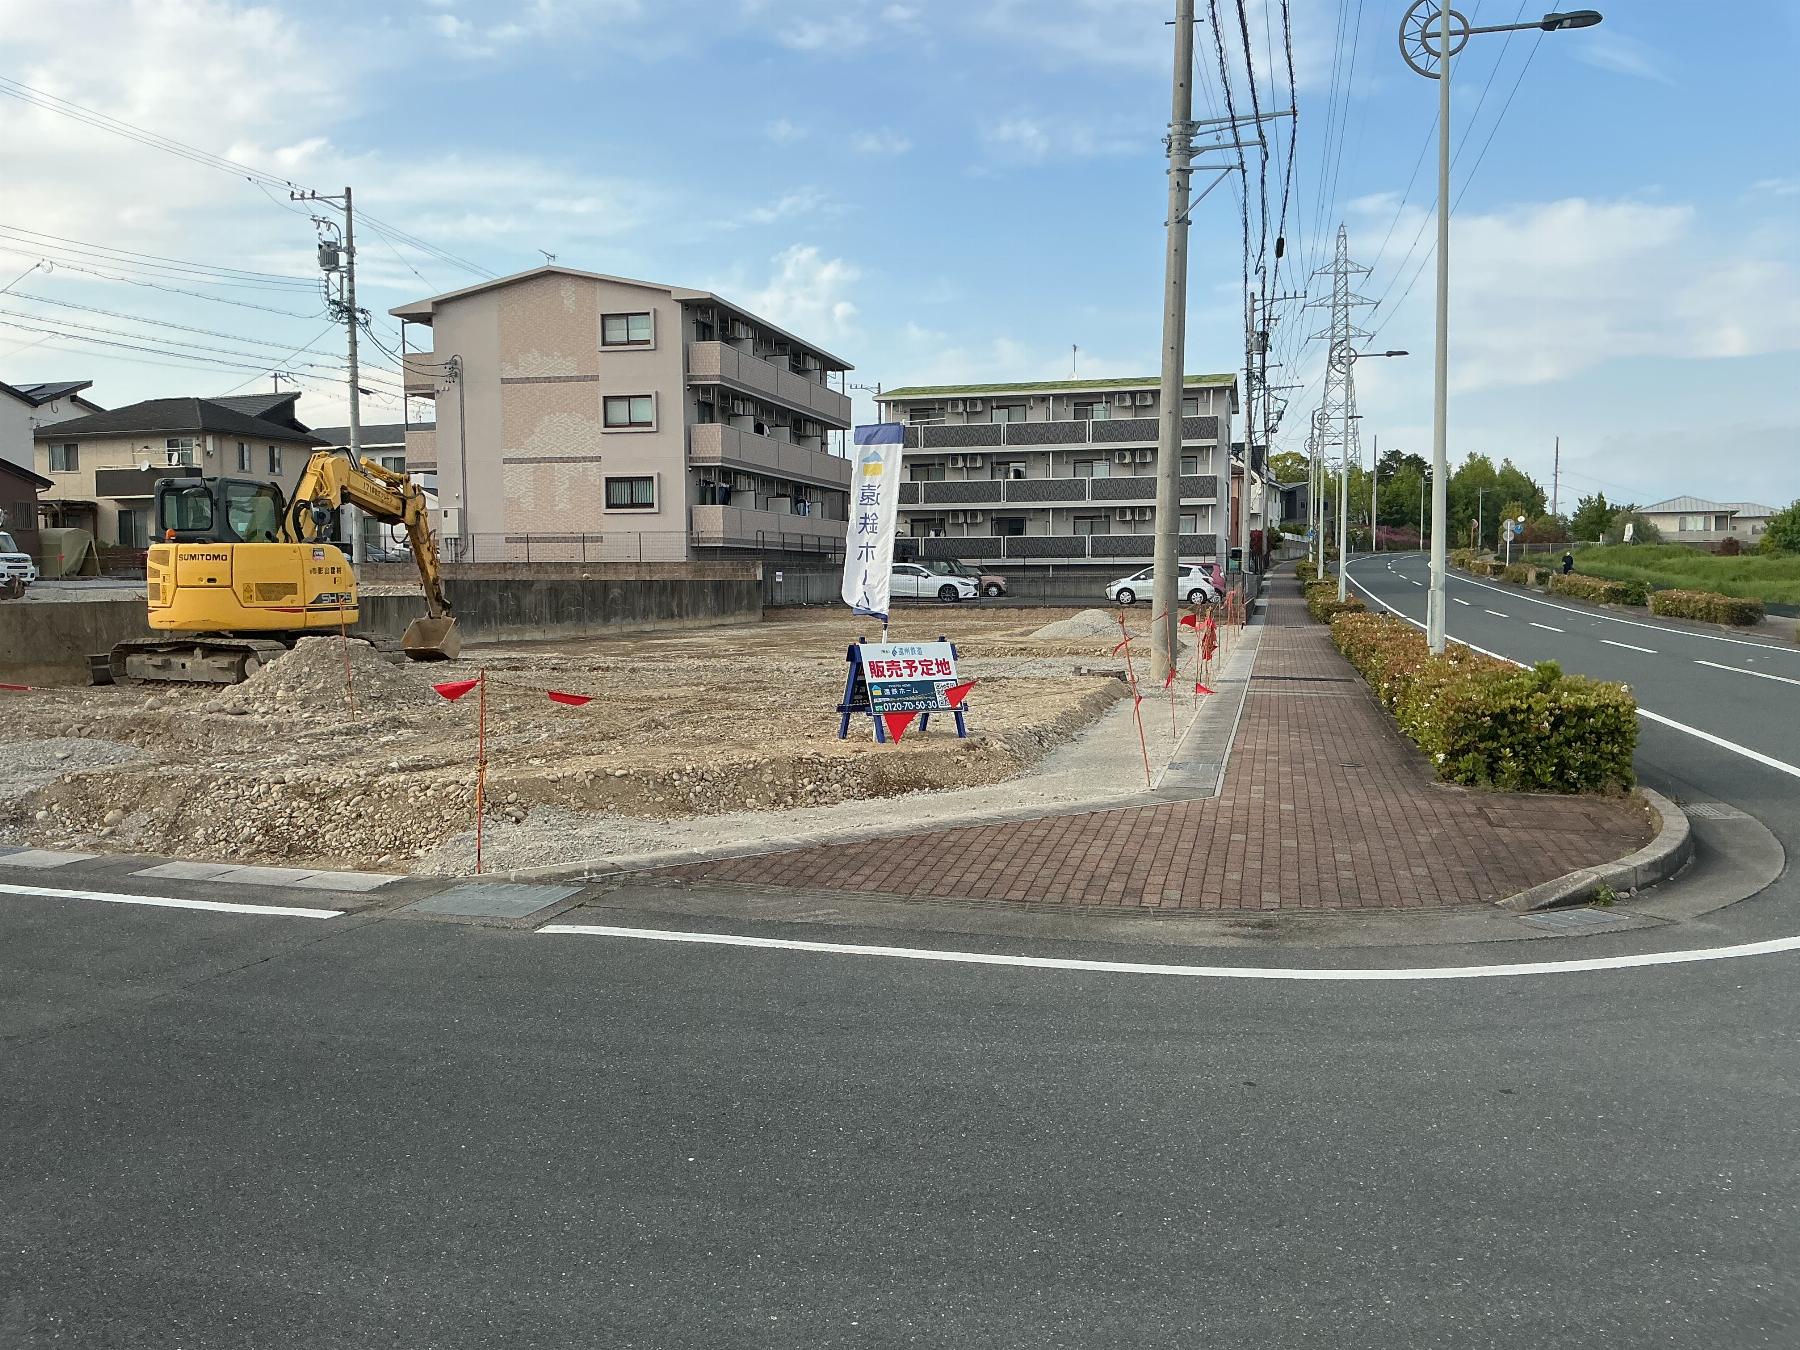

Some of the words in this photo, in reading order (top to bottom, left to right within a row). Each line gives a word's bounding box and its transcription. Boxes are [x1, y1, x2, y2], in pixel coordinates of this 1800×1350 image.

[178, 553, 228, 561] SUMITOMO
[868, 658, 952, 678] 販売予定地
[883, 700, 938, 711] 0120-70-50-30
